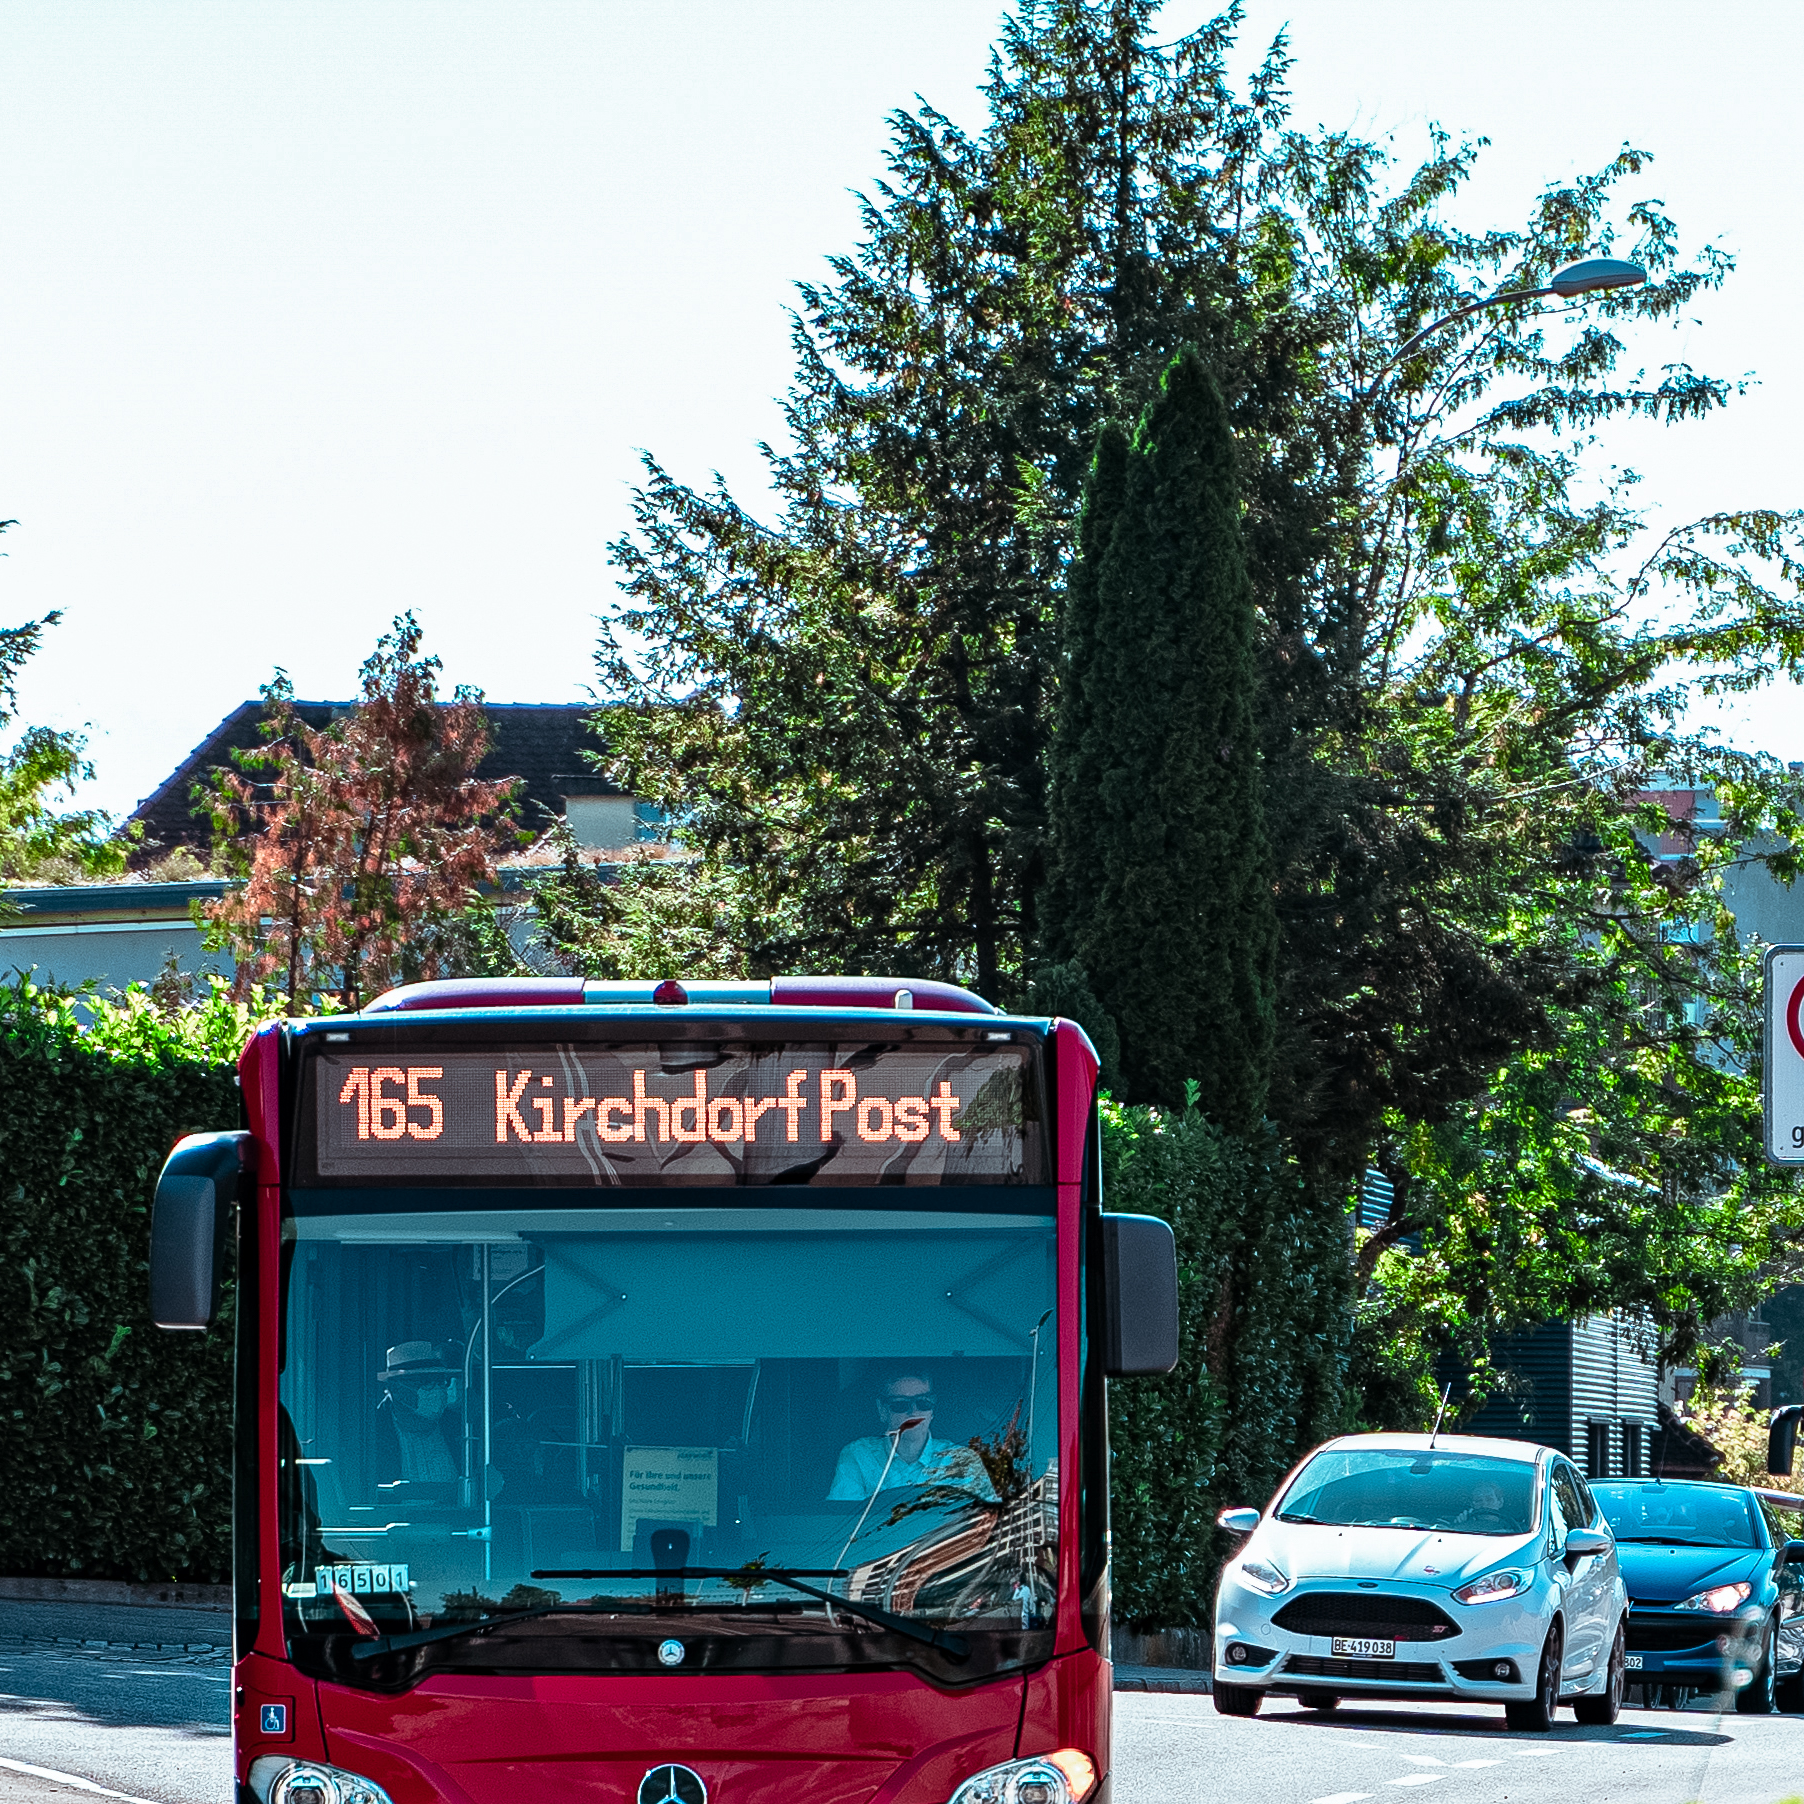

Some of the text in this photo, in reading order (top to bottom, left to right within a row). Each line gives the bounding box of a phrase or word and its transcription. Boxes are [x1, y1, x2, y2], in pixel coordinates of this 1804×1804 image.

[339, 1067, 960, 1143] 165 Kirchdorf Post
